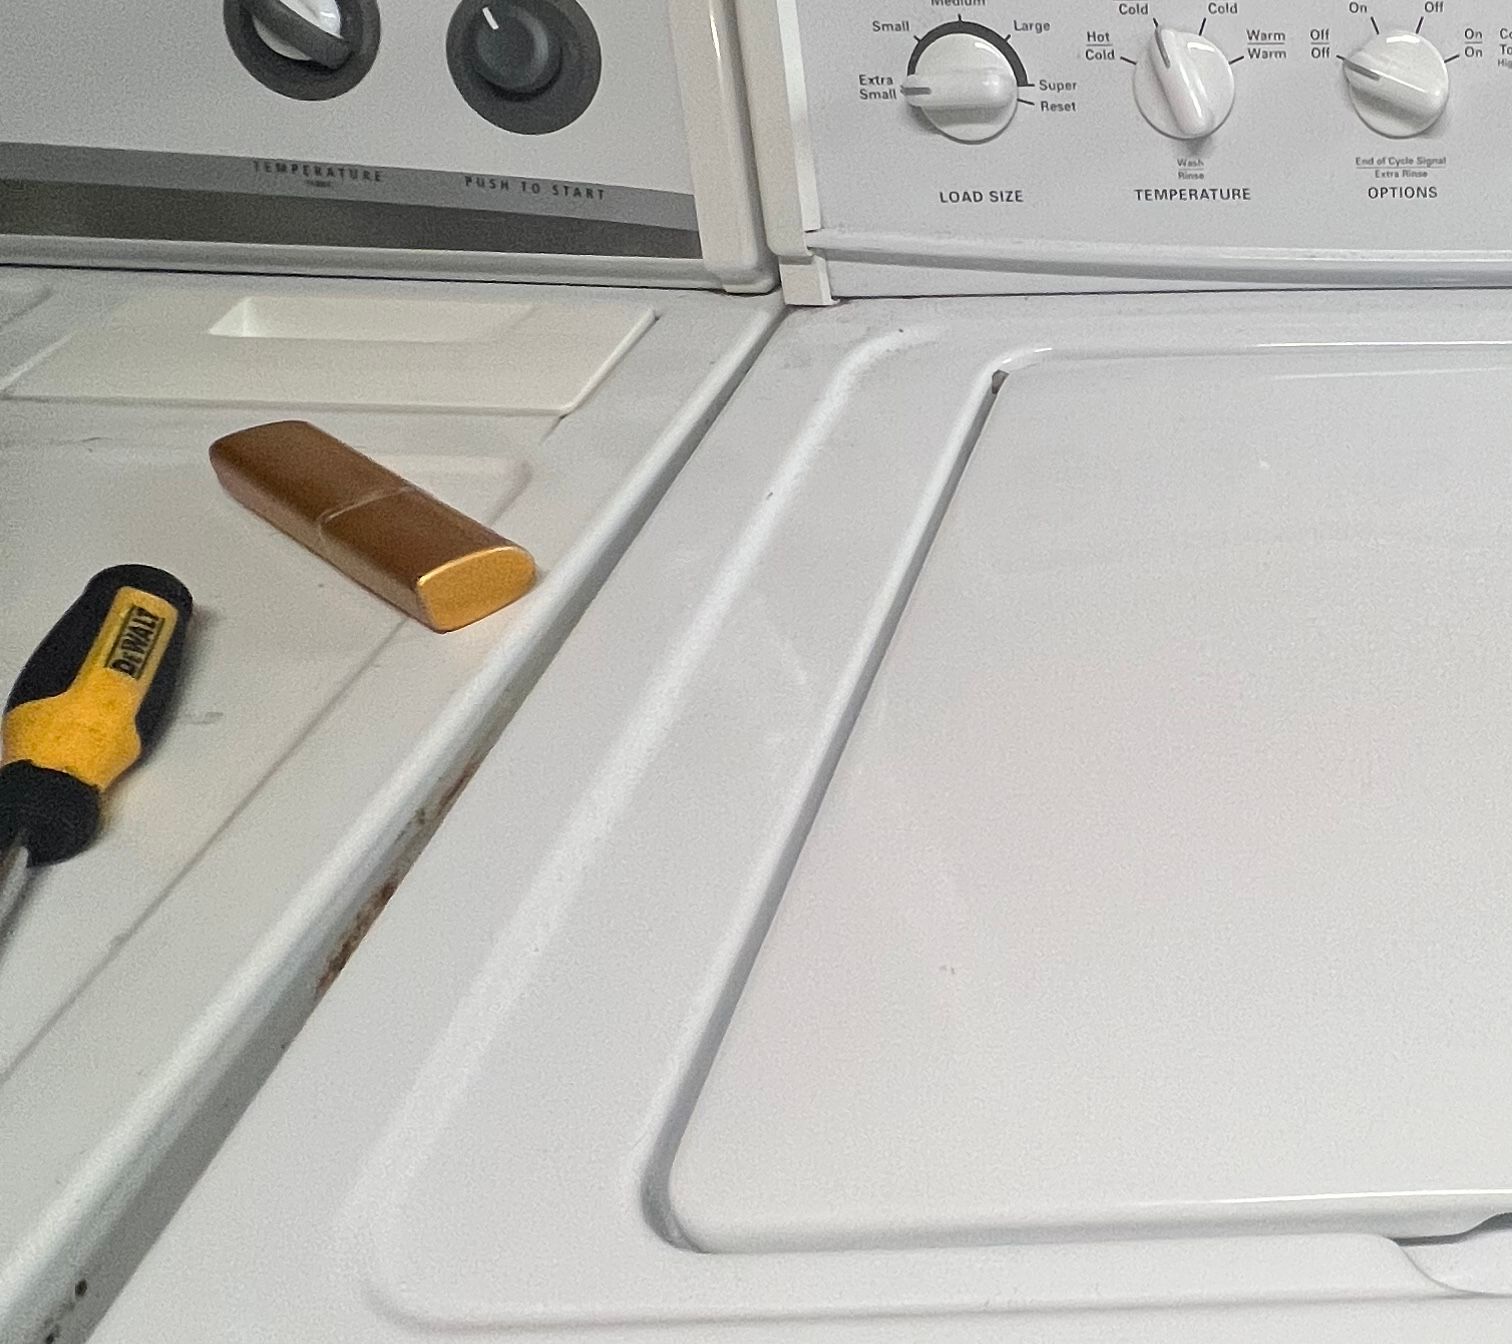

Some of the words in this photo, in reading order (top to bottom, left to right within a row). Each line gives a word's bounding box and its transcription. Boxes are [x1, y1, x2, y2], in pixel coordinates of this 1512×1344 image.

[1118, 3, 1149, 16] Cold
[1207, 2, 1238, 15] Cold
[1349, 1, 1368, 14] On
[1424, 1, 1444, 14] Off
[872, 21, 910, 32] Small
[1014, 20, 1051, 34] Large
[1087, 31, 1111, 42] Hot
[1246, 29, 1286, 41] Warm
[1310, 29, 1330, 41] Off
[1464, 28, 1483, 40] On
[1085, 49, 1115, 61] Cold
[1247, 47, 1287, 59] Warm
[1311, 47, 1330, 59] Off
[1464, 46, 1483, 58] On
[859, 74, 894, 86] Extra
[1039, 80, 1077, 94] Super
[859, 89, 897, 100] Small
[1040, 101, 1076, 112] Reset
[1177, 159, 1205, 167] Wash
[1355, 157, 1374, 166] End
[1376, 156, 1387, 166] of
[1388, 156, 1414, 167] Cycle
[1416, 156, 1447, 167] Signal
[253, 160, 383, 182] TEMPERATURE
[1178, 171, 1205, 179] Rinse
[1375, 169, 1400, 178] Extra
[1402, 169, 1428, 178] Rinse
[464, 175, 510, 192] PUSH
[521, 180, 541, 195] TO
[552, 184, 605, 201] START
[1368, 186, 1438, 199] OPTIONS
[939, 190, 983, 204] LOAD
[988, 189, 1024, 203] SIZE
[1134, 188, 1251, 201] TEMPERATURE
[111, 607, 160, 677] DEWALT
